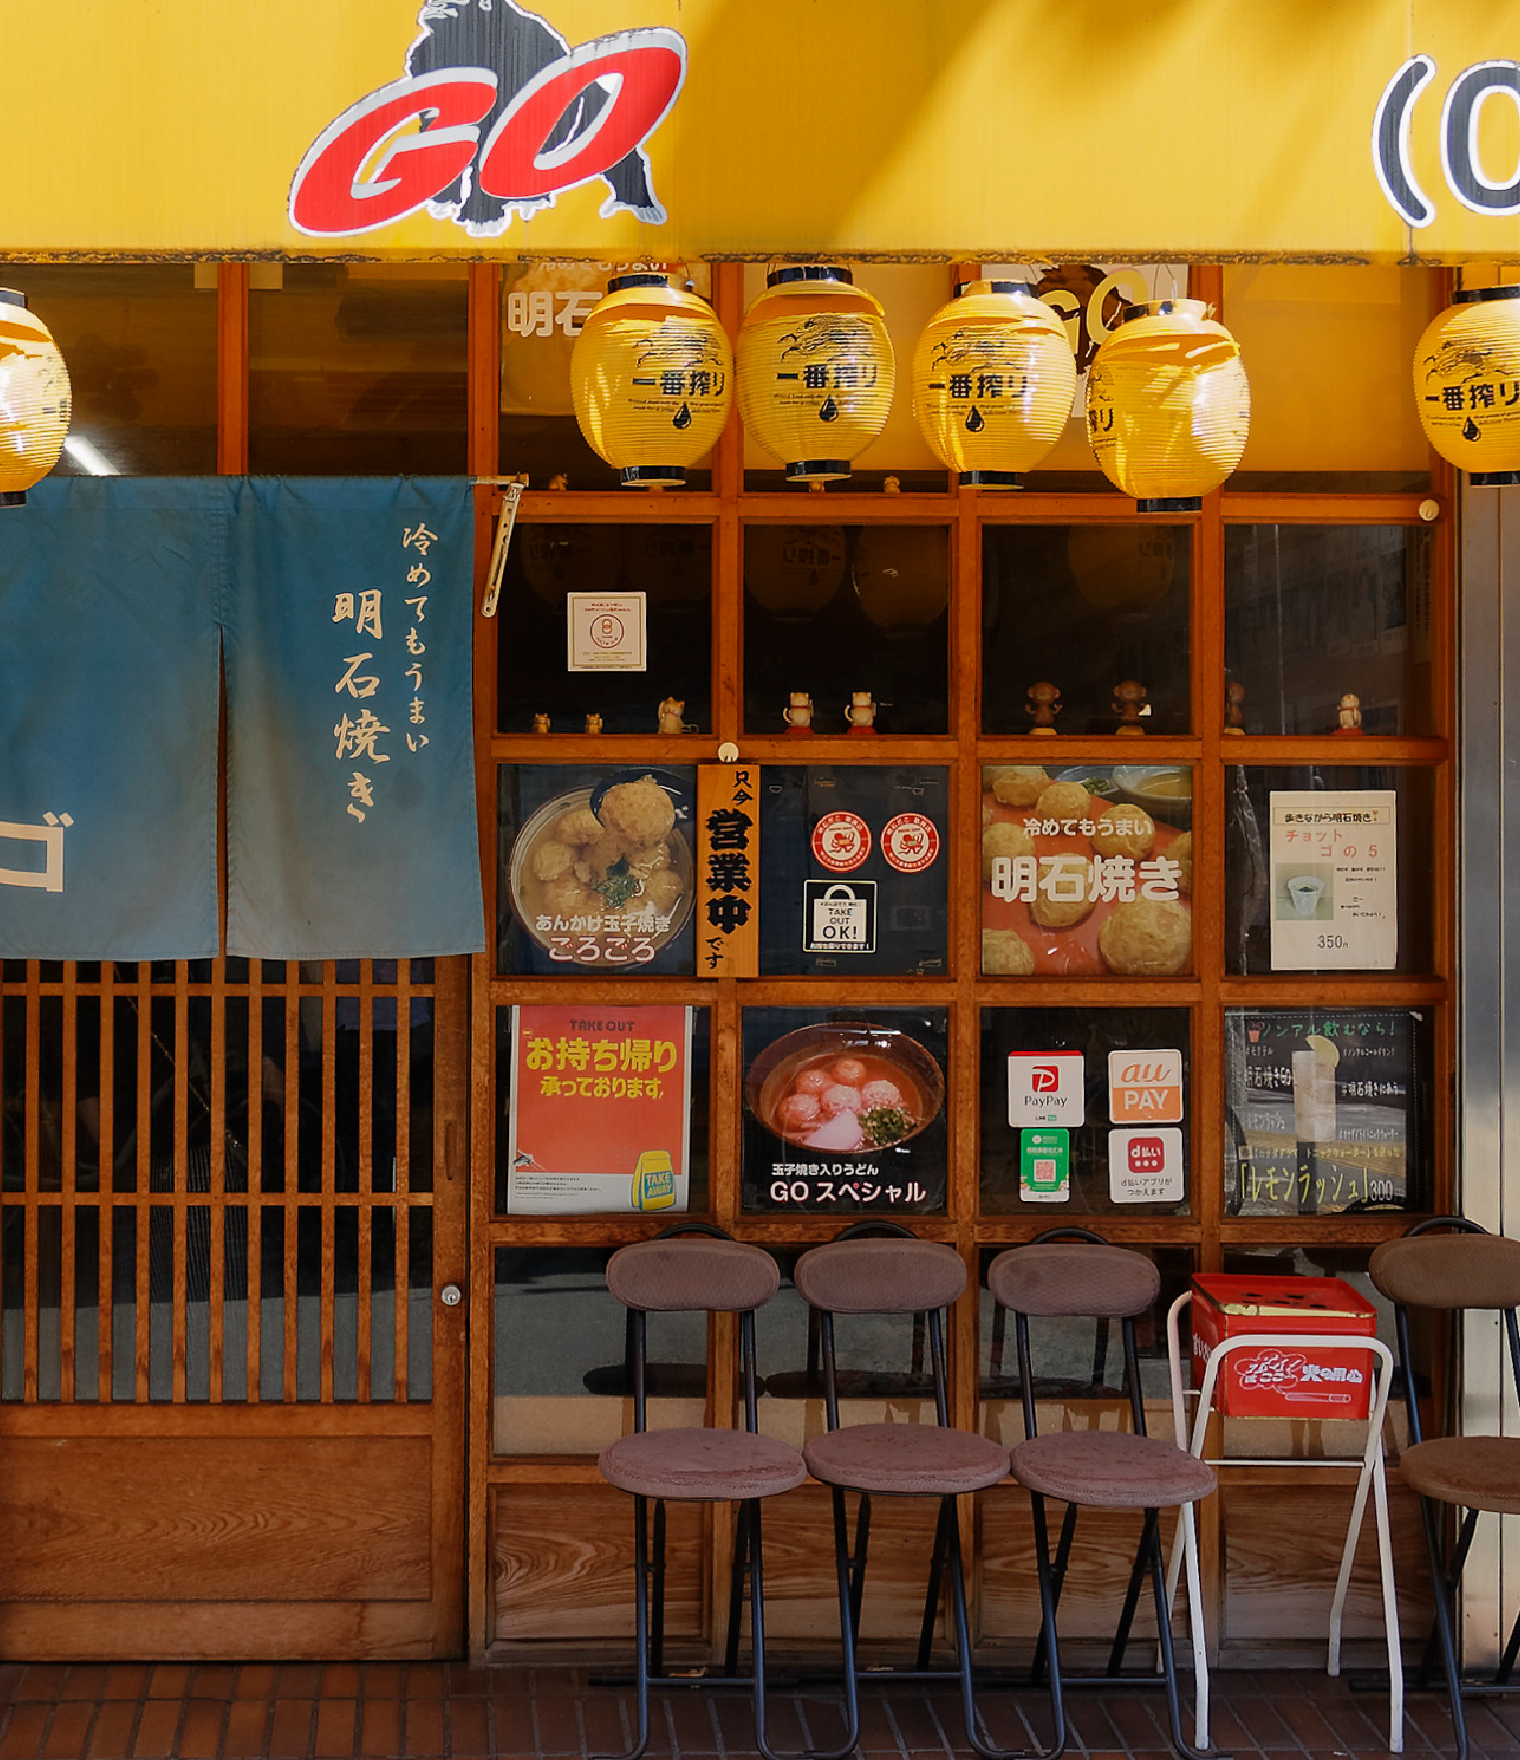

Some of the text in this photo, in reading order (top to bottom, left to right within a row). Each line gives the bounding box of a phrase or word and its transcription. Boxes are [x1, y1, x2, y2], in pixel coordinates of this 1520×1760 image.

[288, 27, 687, 237] GO
[632, 369, 726, 397] 一番搾り
[775, 363, 877, 390] 一番搾り
[929, 373, 1031, 400] 一番搾り
[1425, 380, 1520, 412] 一番搾り
[401, 521, 440, 754] 冷めてもうまい
[332, 588, 391, 824] 明石焼き
[1023, 816, 1154, 839] 冷めてもうまい
[705, 808, 754, 934] 営業中
[990, 854, 1182, 904] 明石焼き
[535, 913, 672, 933] あんかけ玉子焼き
[828, 907, 853, 916] TAKE
[829, 917, 851, 925] OUT
[822, 925, 857, 940] OK!
[705, 936, 724, 969] です
[569, 1019, 635, 1032] TAKE OUT
[525, 1036, 678, 1074] お持ち帰り
[1120, 1063, 1172, 1083] au
[1024, 1095, 1068, 1108] PayPay
[1124, 1089, 1169, 1110] PAY
[1131, 1144, 1162, 1158] d払い
[771, 1163, 880, 1176] 玉子焼き入りうどん
[769, 1180, 927, 1203] GO スペシャル
